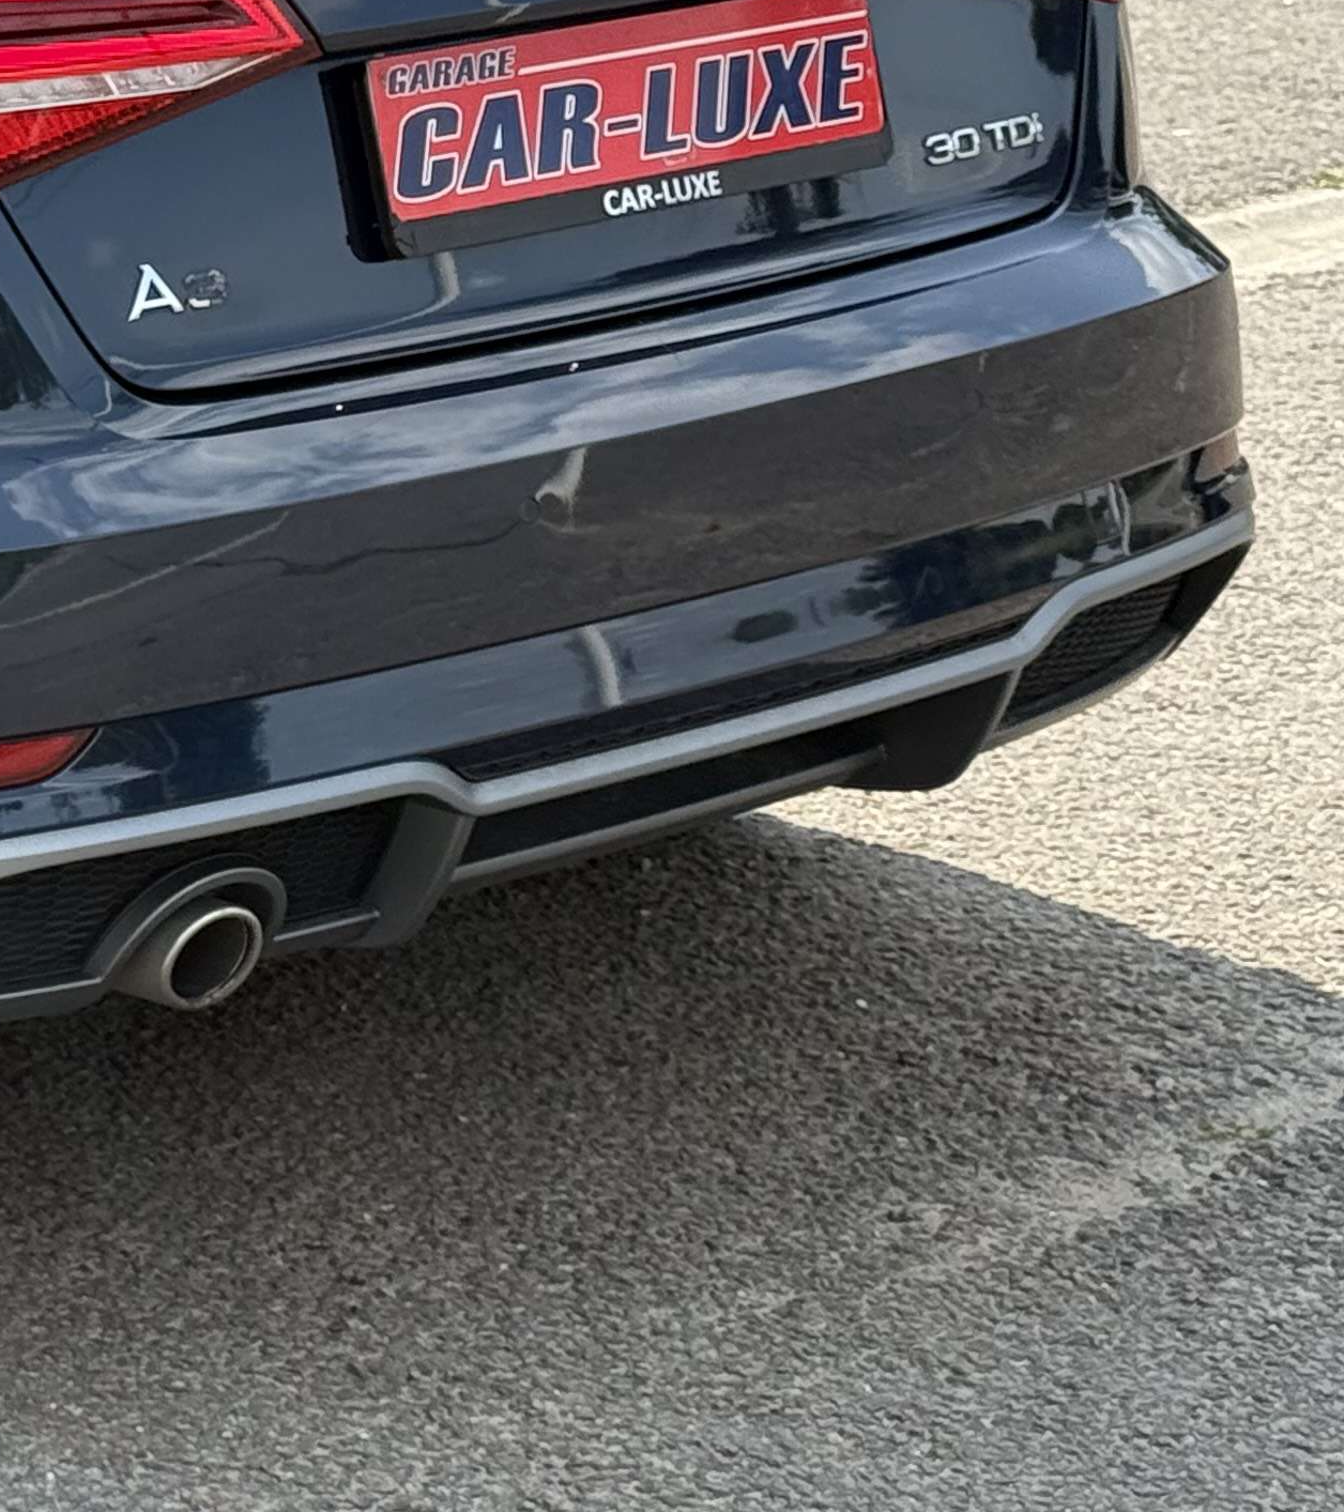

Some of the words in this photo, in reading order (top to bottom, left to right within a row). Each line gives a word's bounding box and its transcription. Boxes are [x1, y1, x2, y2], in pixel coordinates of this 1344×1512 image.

[387, 46, 516, 99] GARAGE
[393, 31, 869, 204] CAR-LUXE
[924, 126, 981, 166] 30
[603, 170, 723, 217] CAR-LUXE
